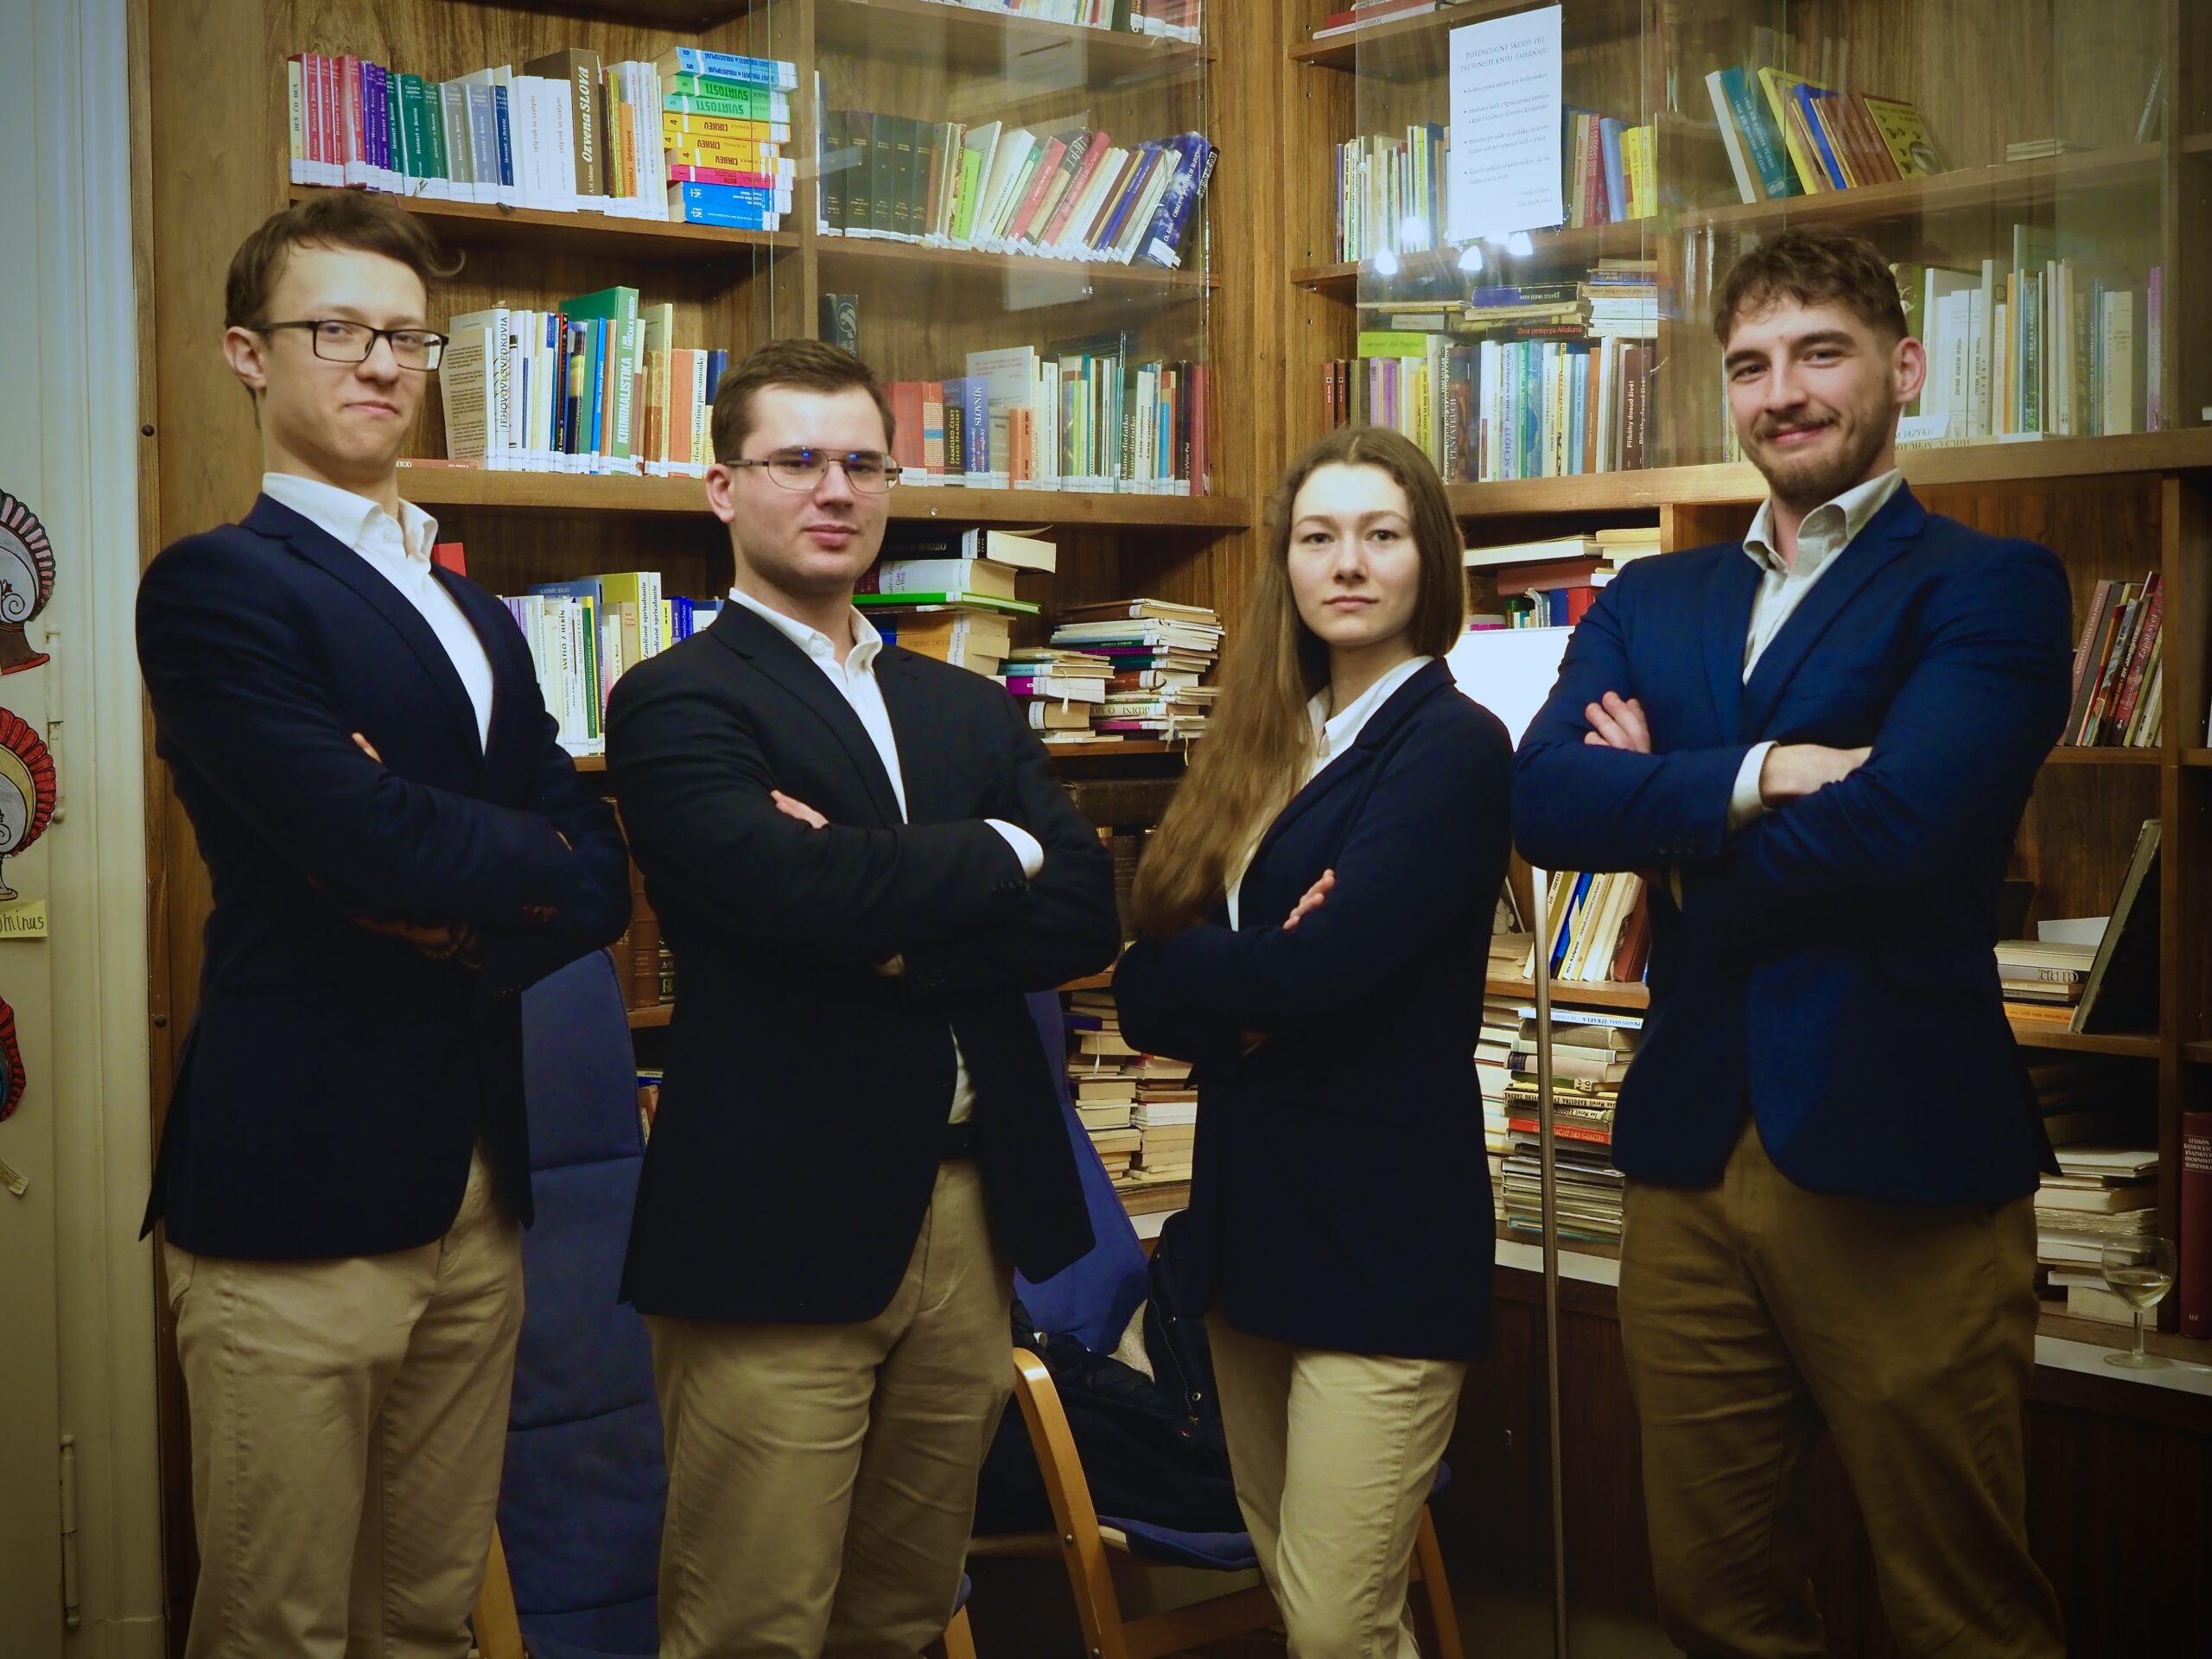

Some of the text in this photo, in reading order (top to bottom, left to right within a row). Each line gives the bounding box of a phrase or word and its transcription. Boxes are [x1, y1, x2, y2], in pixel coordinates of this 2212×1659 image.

[705, 83, 747, 100] SVIATOSTI
[294, 102, 299, 111] ČO
[696, 100, 743, 115] SVIATOSTI
[578, 66, 593, 162] Ozvena SLOVA
[703, 122, 728, 131] CIRKEV
[697, 139, 720, 149] CIRKEV
[715, 156, 738, 165] CIRKEV
[618, 357, 632, 443] KRIMINALISTIKA
[1904, 429, 1935, 440] JAZYKU
[2145, 613, 2157, 632] svet
[1582, 1017, 1607, 1026] IZRAELA
[1585, 1081, 1591, 1090] 10
